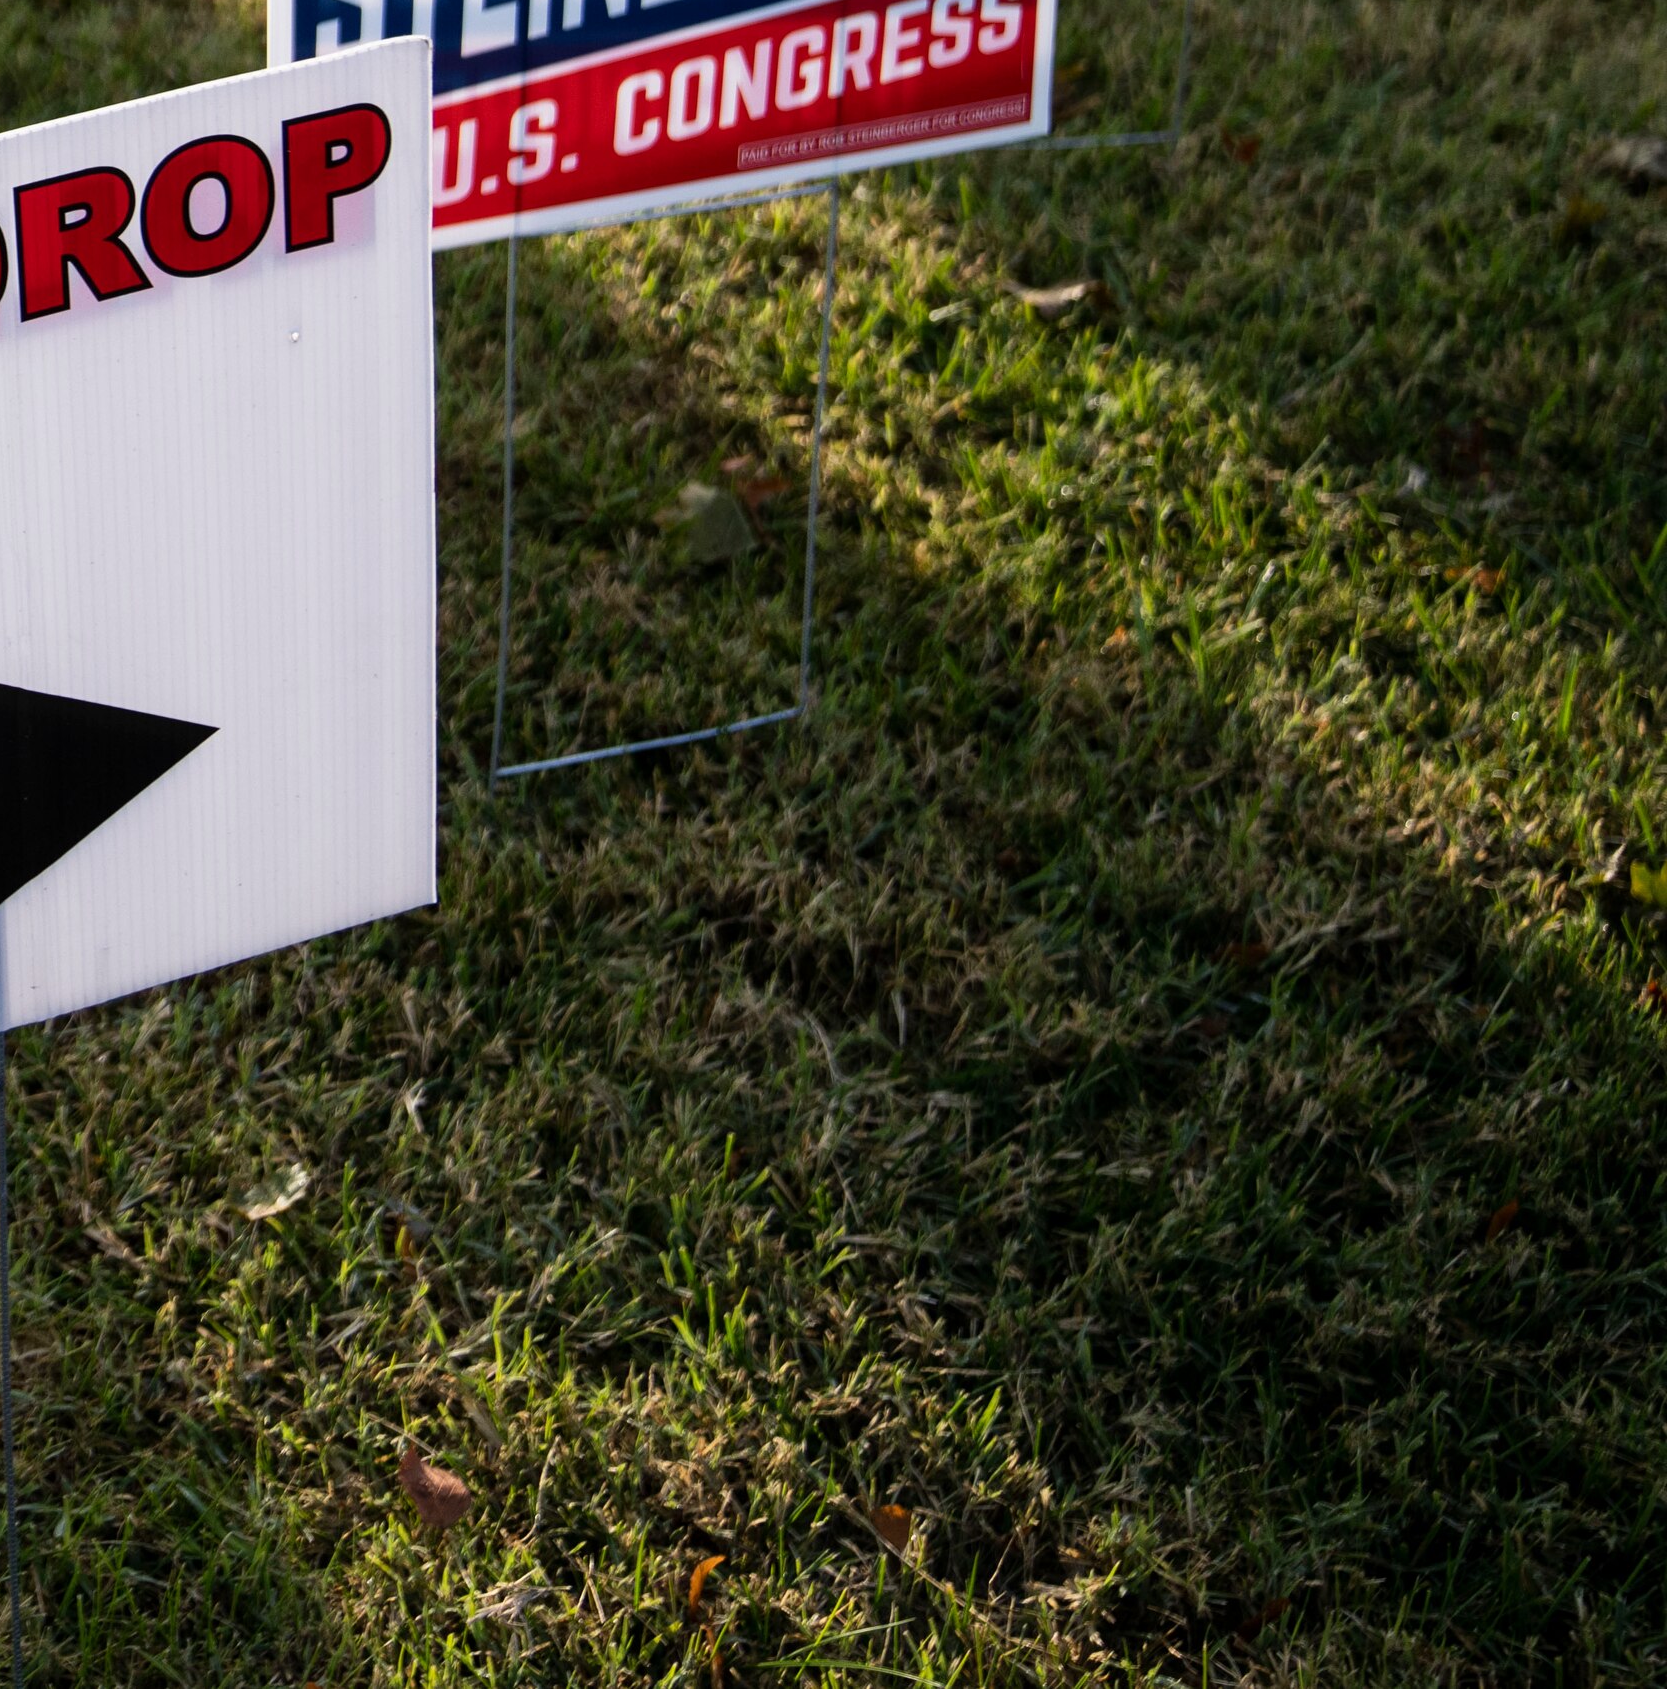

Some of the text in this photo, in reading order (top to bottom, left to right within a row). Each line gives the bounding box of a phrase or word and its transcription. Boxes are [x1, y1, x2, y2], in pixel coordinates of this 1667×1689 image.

[433, 99, 579, 207] U.S.
[741, 100, 1023, 162] PAID FOR BY ROB STEINBERGER FOR CONGRESS
